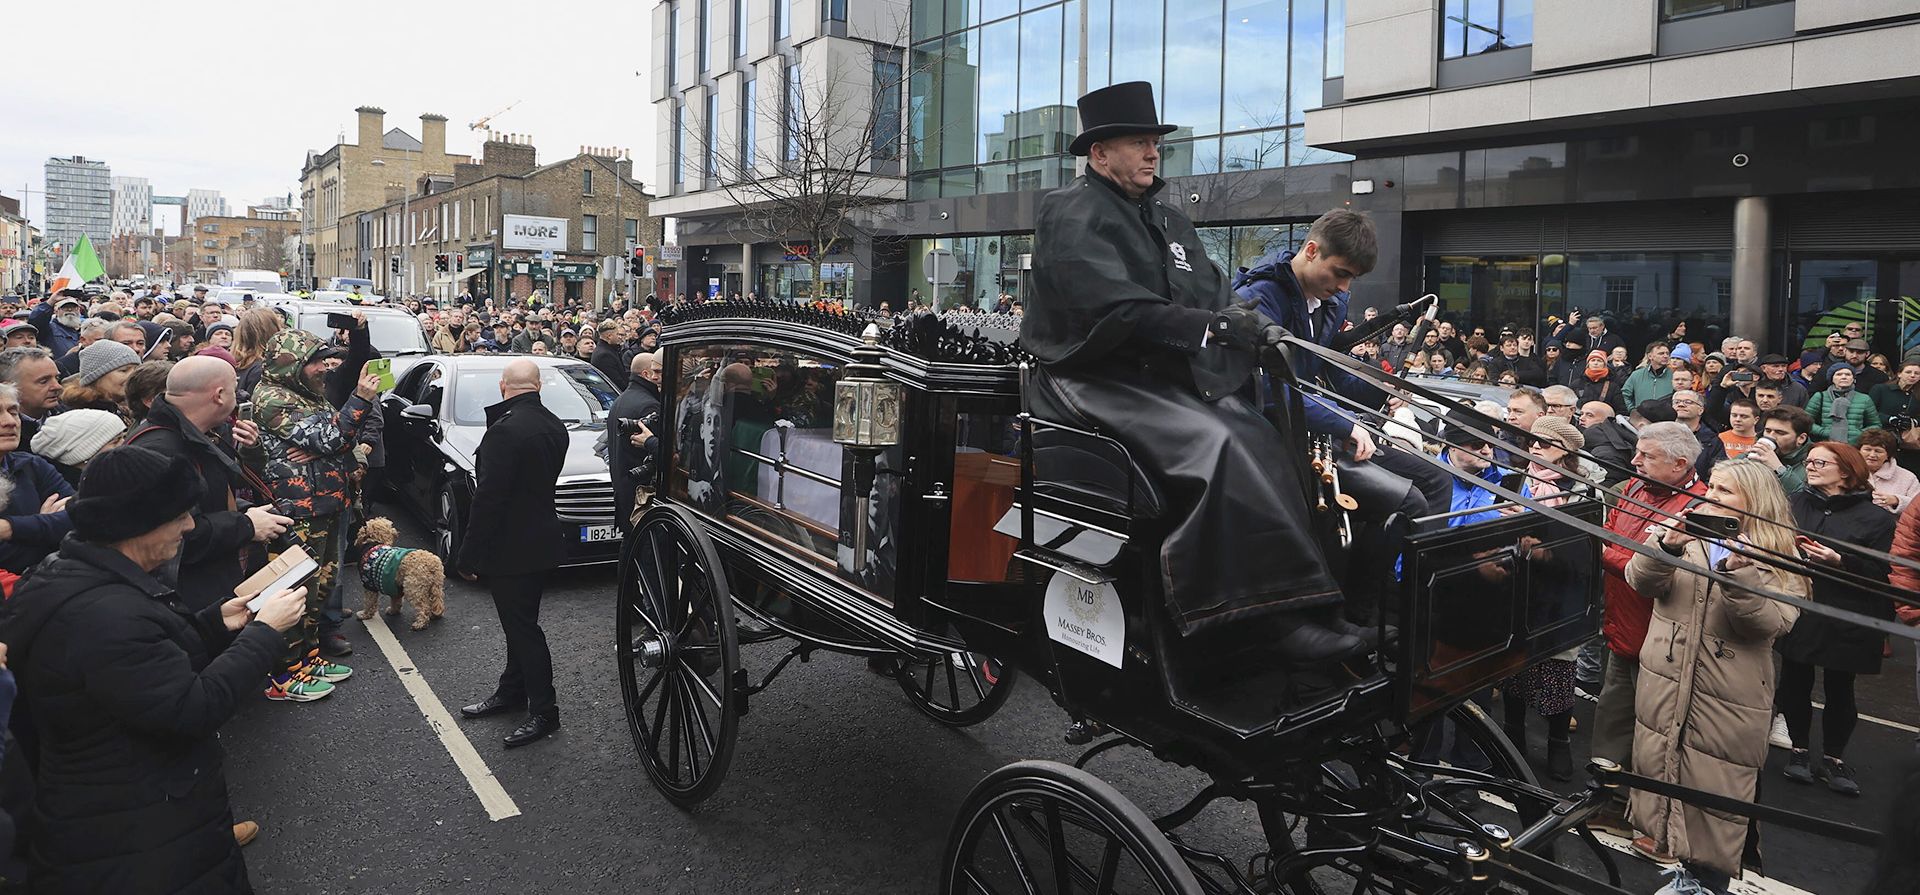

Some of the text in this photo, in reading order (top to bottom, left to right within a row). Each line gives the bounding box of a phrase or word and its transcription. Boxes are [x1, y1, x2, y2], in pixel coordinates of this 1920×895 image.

[514, 225, 559, 238] MORE
[1077, 587, 1094, 605] MB
[1061, 633, 1101, 655] Honouring Life
